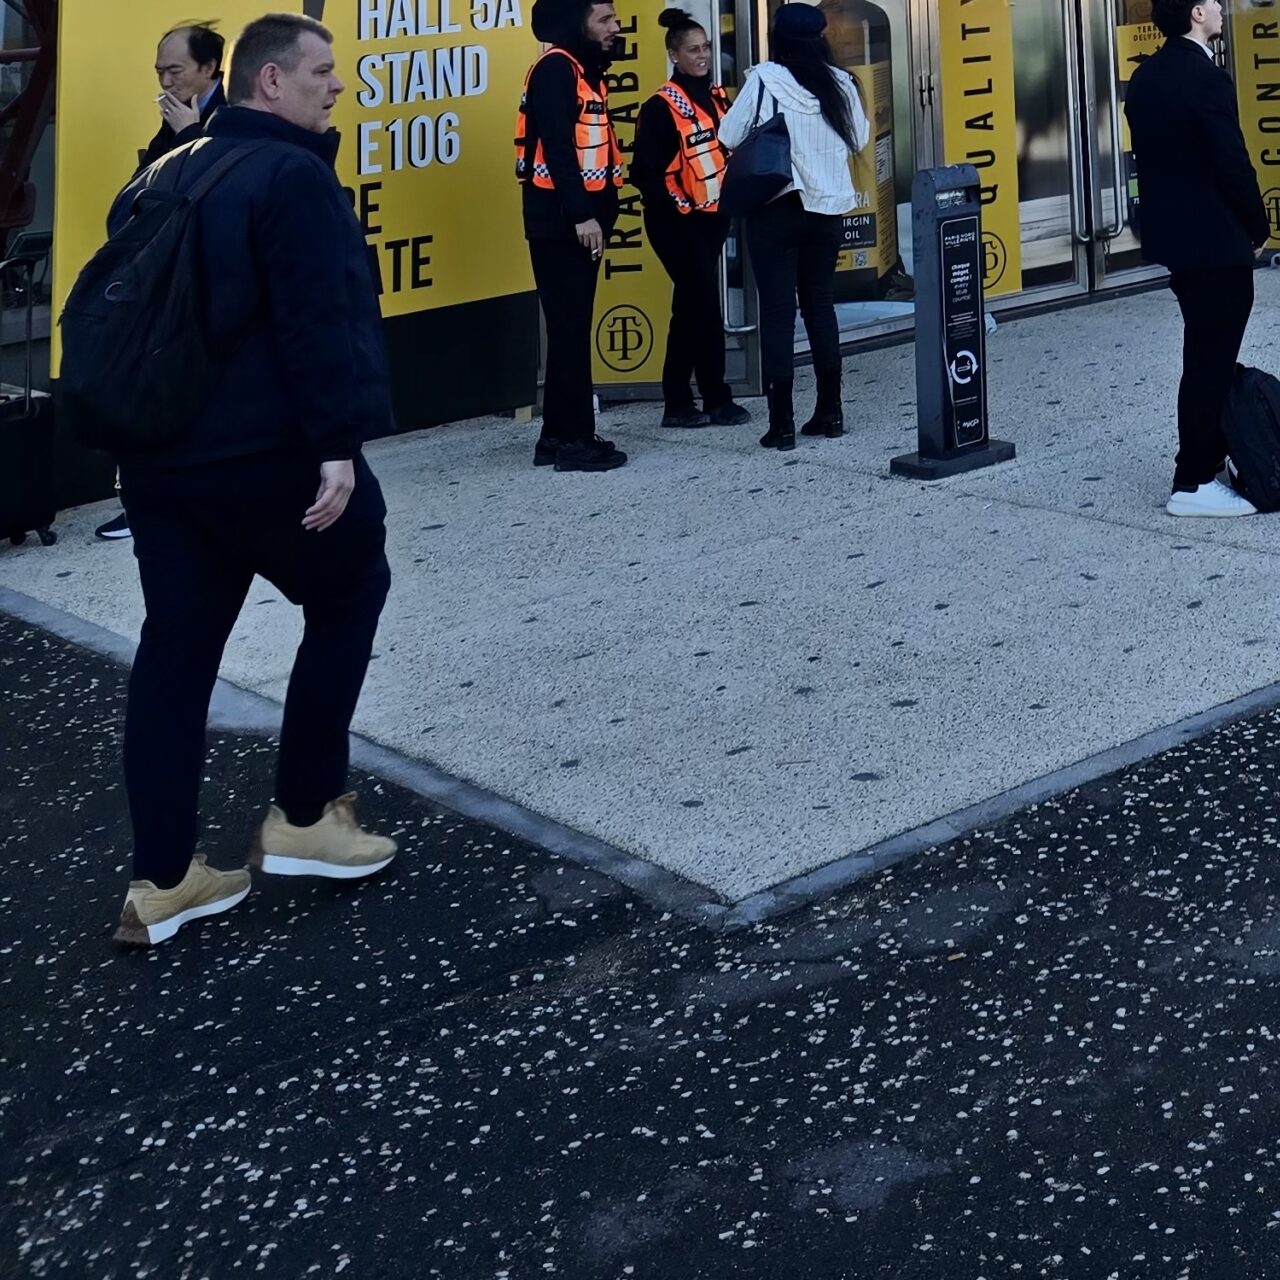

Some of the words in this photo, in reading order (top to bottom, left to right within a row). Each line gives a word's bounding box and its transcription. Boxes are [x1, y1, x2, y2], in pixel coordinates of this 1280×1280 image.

[357, 44, 489, 109] STAND
[357, 111, 460, 175] E106
[842, 216, 870, 228] IRGIN
[844, 231, 860, 240] OIL
